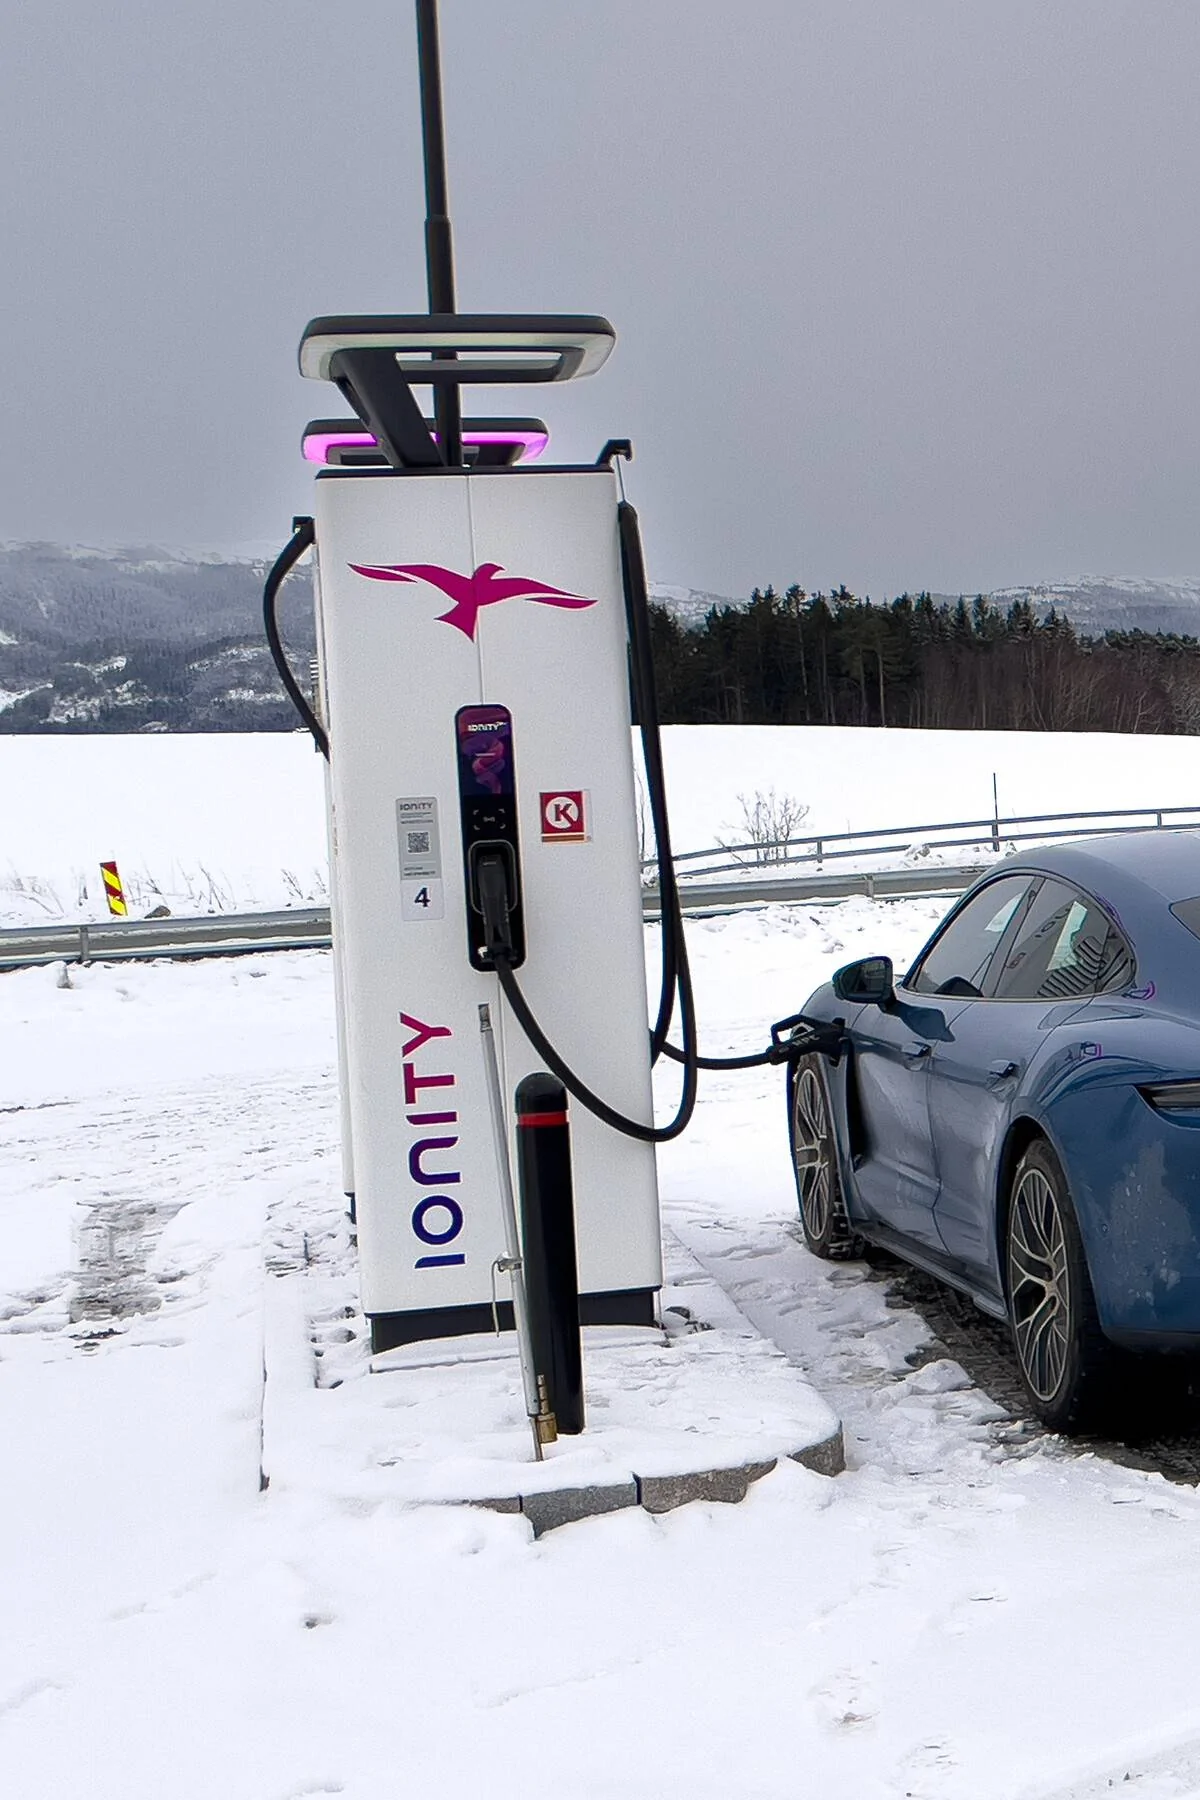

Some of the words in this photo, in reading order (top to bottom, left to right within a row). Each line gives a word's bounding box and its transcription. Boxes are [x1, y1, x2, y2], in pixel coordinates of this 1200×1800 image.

[553, 802, 577, 828] K
[414, 887, 431, 908] 4
[399, 1011, 466, 1269] IONITY
